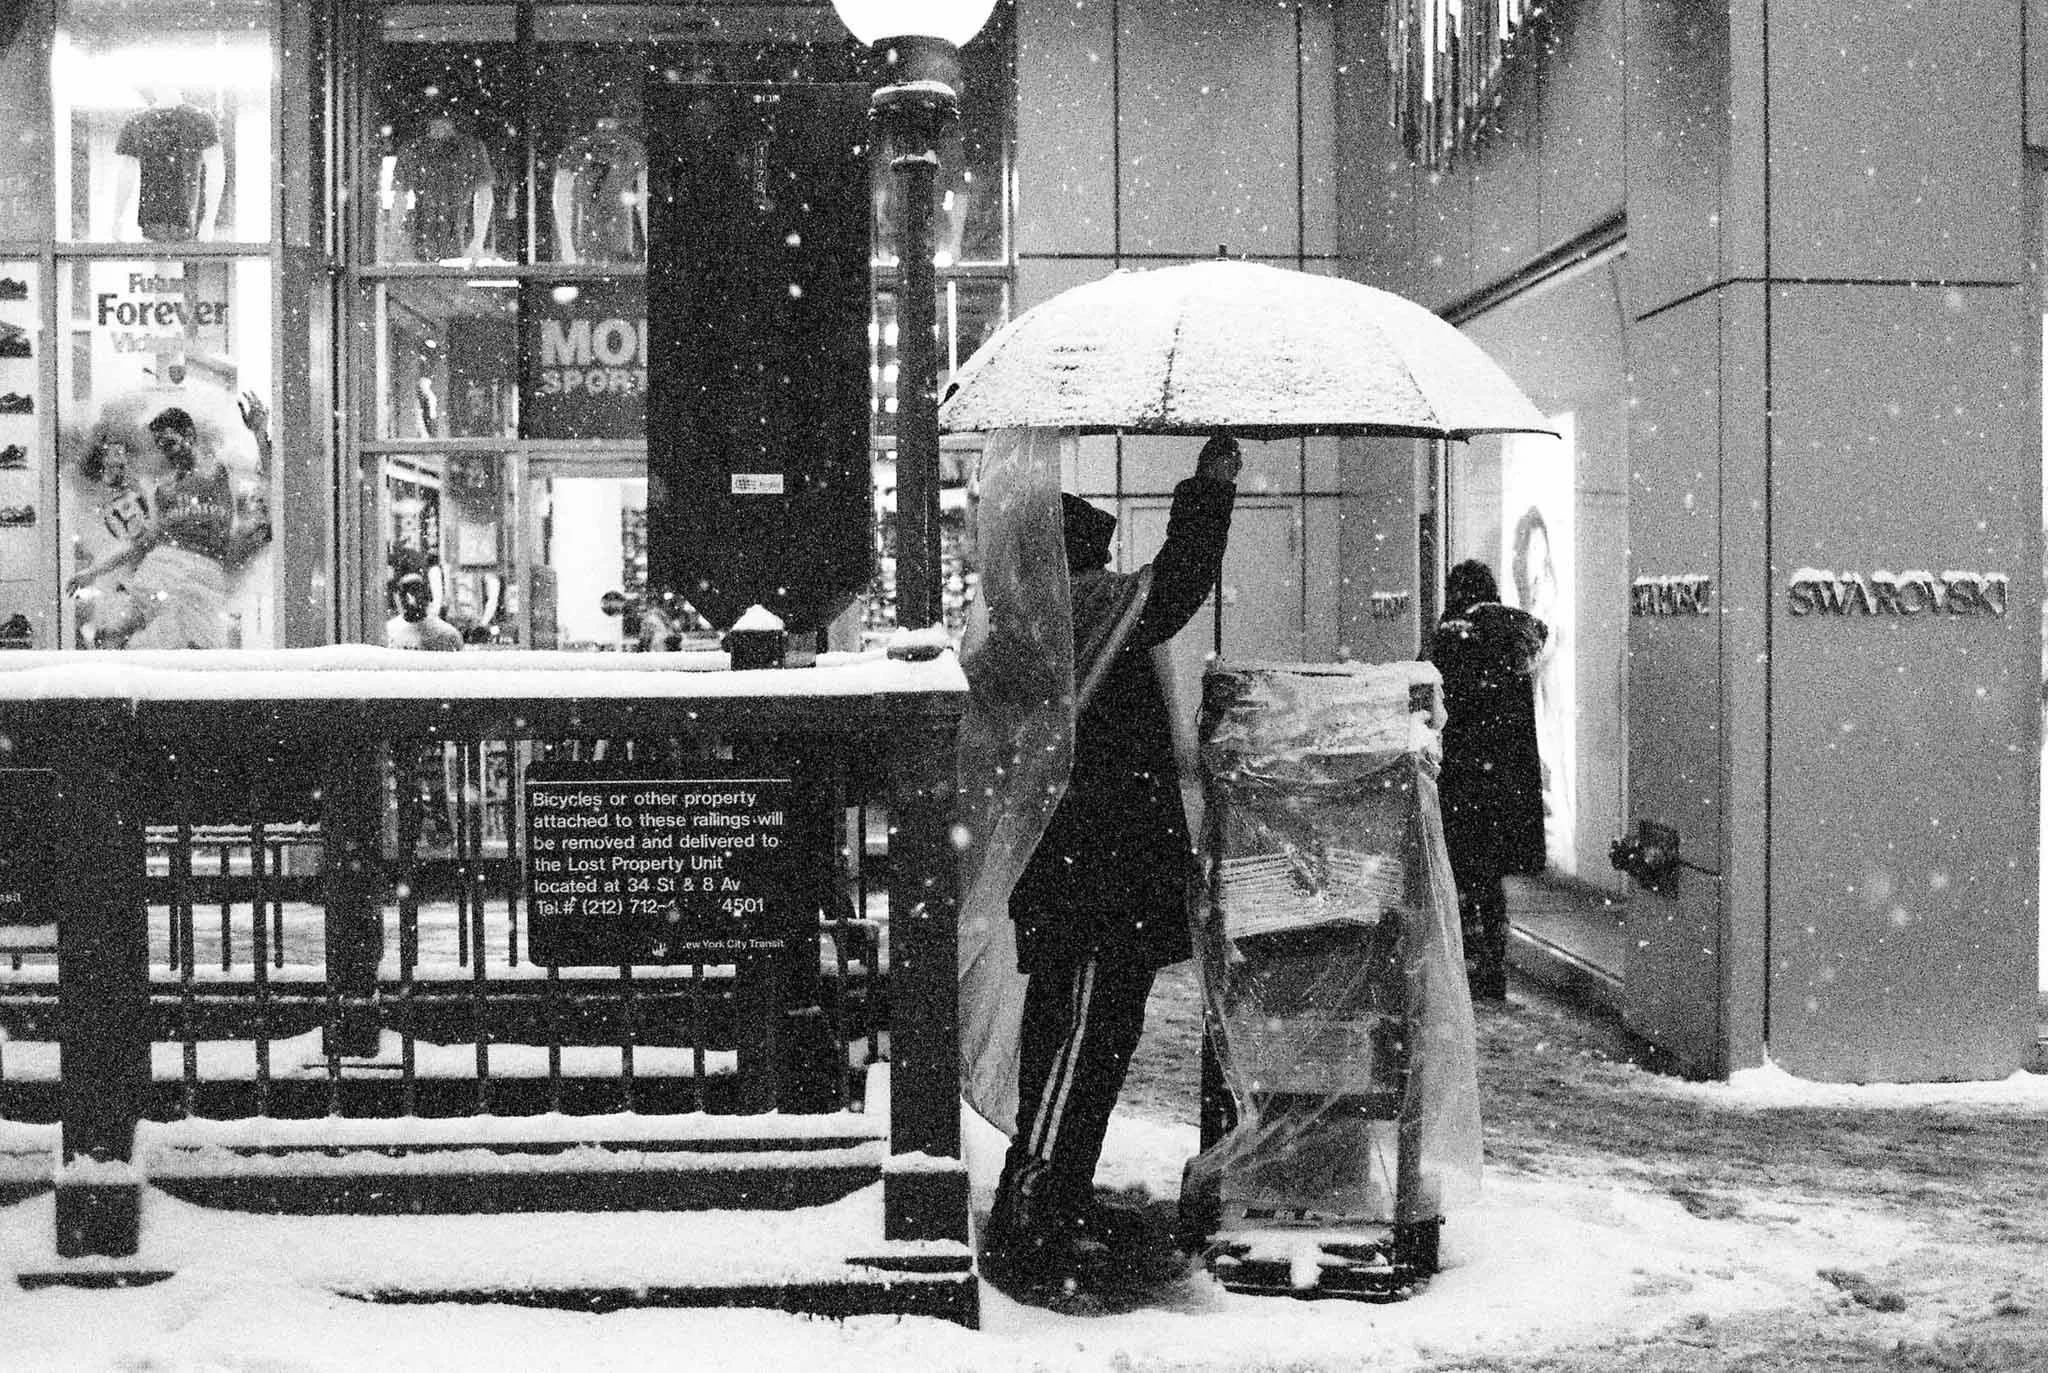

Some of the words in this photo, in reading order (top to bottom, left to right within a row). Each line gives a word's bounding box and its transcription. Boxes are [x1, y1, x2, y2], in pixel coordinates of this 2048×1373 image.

[97, 292, 228, 326] Forever
[1788, 570, 2010, 616] SWAROVSKI
[533, 791, 602, 809] Bicycles
[609, 794, 628, 806] or
[634, 791, 678, 805] other
[684, 791, 756, 808] property
[534, 813, 608, 828] attached
[615, 814, 632, 828] to
[639, 813, 687, 827] these
[693, 811, 751, 829] railings
[757, 811, 783, 826] will
[534, 835, 555, 850] be
[561, 834, 635, 850] removed
[641, 834, 673, 849] and
[679, 833, 755, 848] delivered
[761, 833, 779, 848] to
[535, 857, 561, 872] the
[567, 856, 606, 871] Lost
[611, 855, 684, 873] Property
[690, 855, 723, 870] Unit
[534, 879, 597, 893] located
[603, 878, 620, 893] at
[627, 877, 650, 892] 34
[657, 877, 674, 892] St
[683, 877, 694, 892] &
[702, 877, 714, 892] 8
[721, 877, 741, 892] Av
[581, 899, 623, 915] (212)
[721, 897, 765, 913] 4501
[679, 940, 701, 950] ew
[701, 939, 725, 949] York
[726, 939, 747, 951] City
[749, 938, 784, 949] Transit
